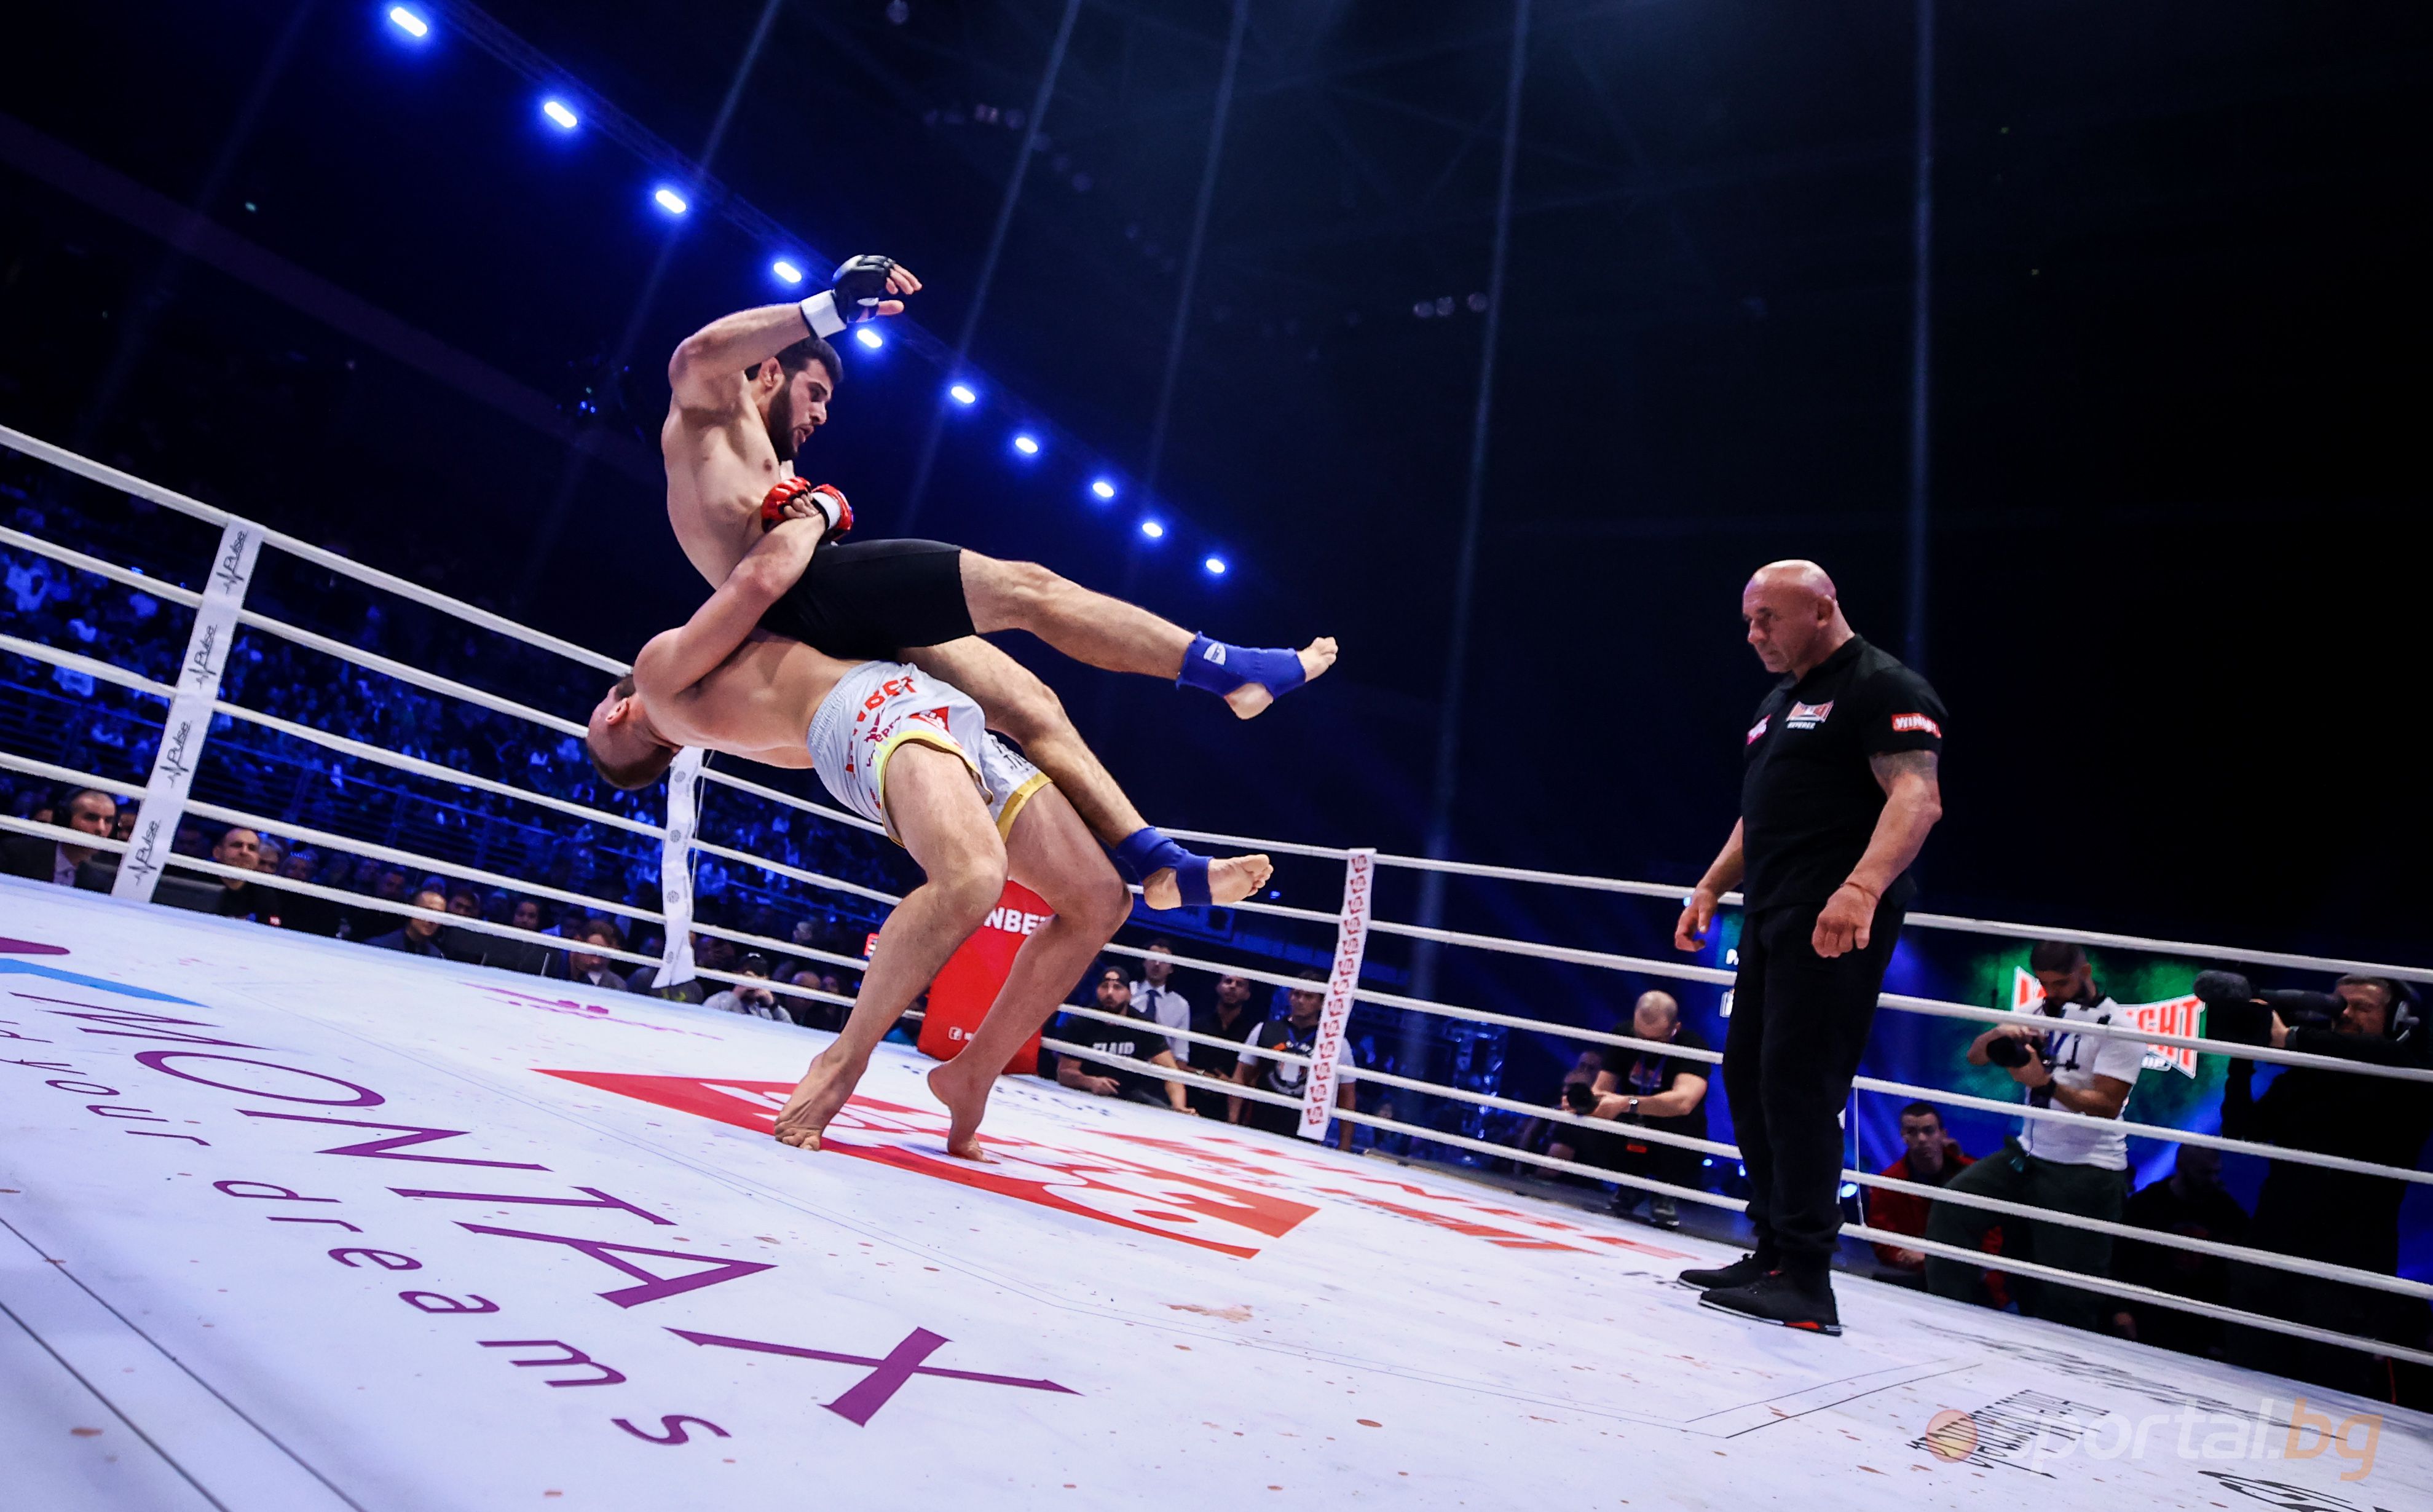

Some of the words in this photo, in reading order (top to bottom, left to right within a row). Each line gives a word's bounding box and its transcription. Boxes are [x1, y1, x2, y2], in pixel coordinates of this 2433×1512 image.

[223, 530, 248, 573] Pulse
[194, 624, 218, 668] Pulse
[167, 720, 192, 764] Pulse
[135, 820, 160, 865] Pulse
[984, 907, 1047, 935] NBE
[9, 991, 1084, 1428] MONTAX
[213, 1179, 732, 1446] dreams
